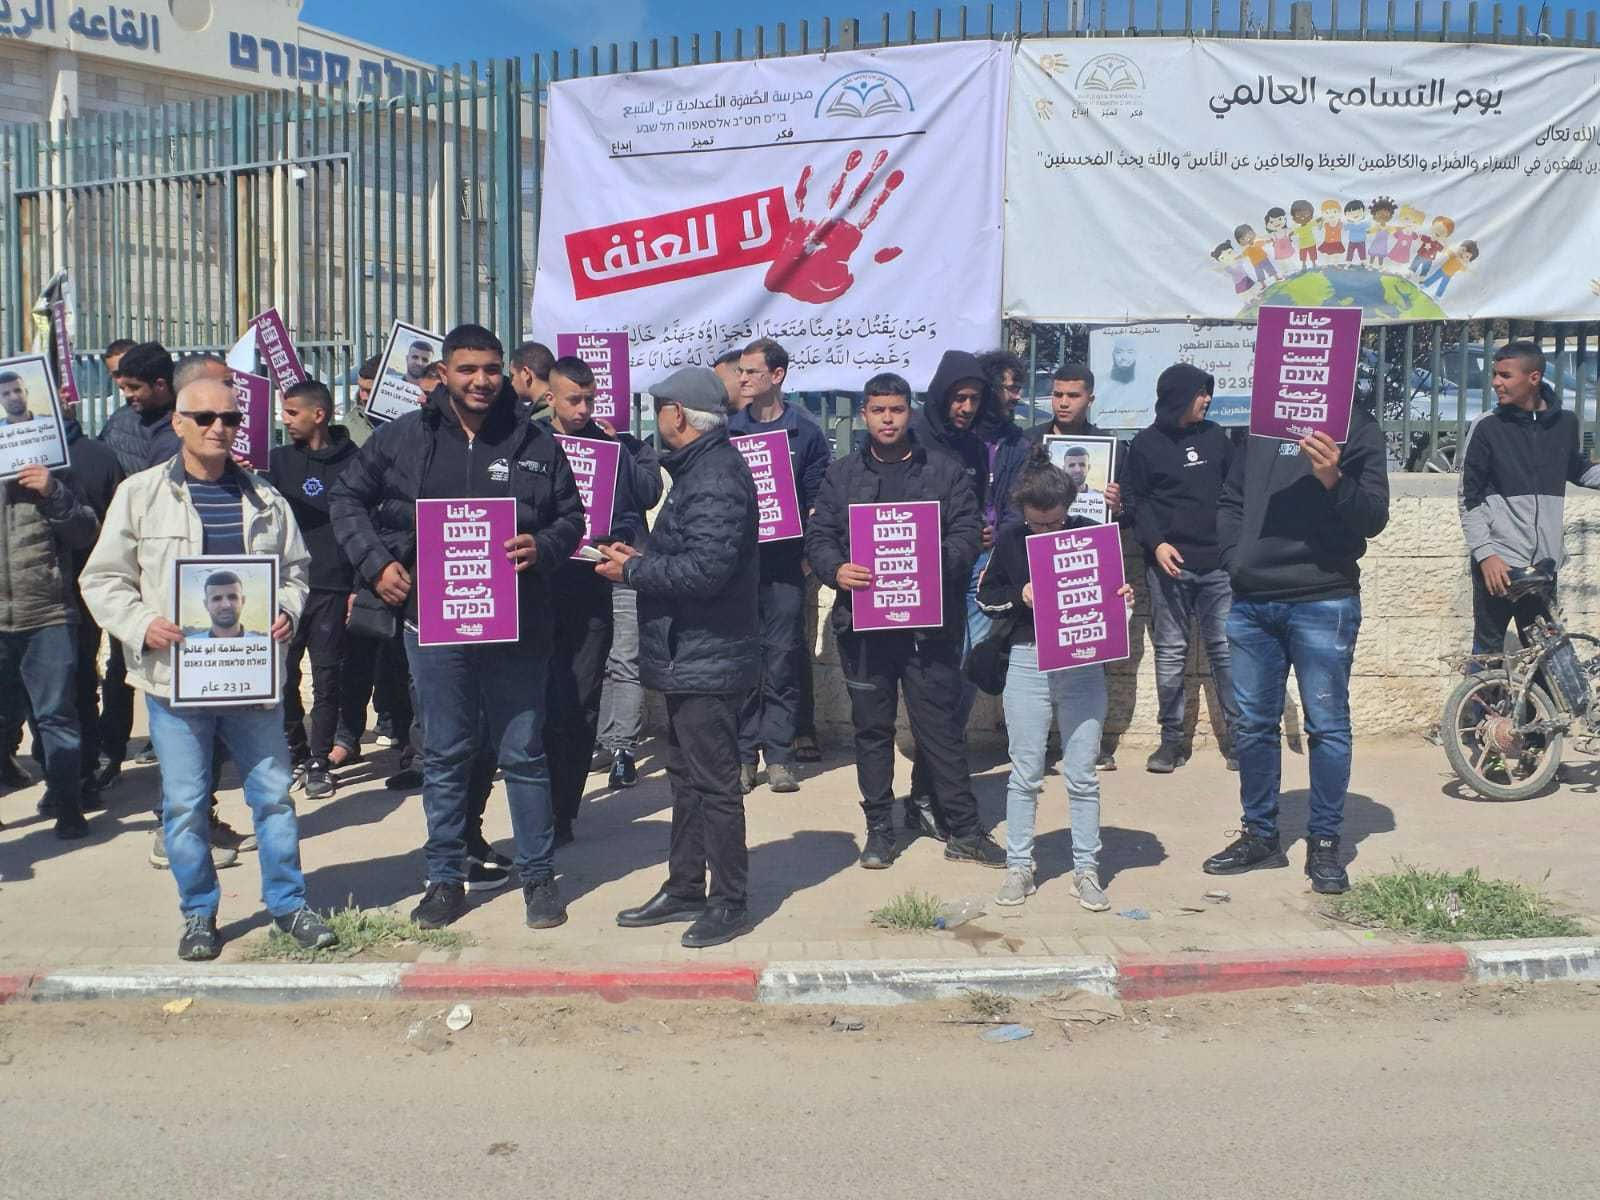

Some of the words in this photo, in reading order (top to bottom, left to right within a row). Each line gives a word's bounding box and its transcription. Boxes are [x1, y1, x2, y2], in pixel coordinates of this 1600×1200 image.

[230, 31, 351, 88] ספורט
[772, 90, 813, 105] مدرسة
[1325, 77, 1446, 114] التسامح
[1452, 87, 1503, 116] يوم
[1535, 124, 1570, 146] تعالى
[1230, 155, 1250, 170] عن
[1318, 153, 1355, 171] الغيظ
[1523, 156, 1541, 177] في
[739, 197, 773, 250] لا
[582, 213, 718, 281] للعنف
[1289, 312, 1332, 328] حياتنا
[1287, 332, 1329, 345] חיינו
[1283, 349, 1330, 366] ليست
[1285, 369, 1325, 381] אינם
[1279, 385, 1327, 403] رخيصة
[1277, 404, 1324, 420] הפקר
[447, 504, 487, 521] حياتنا
[876, 508, 913, 523] حياتنا
[448, 525, 487, 538] חיינו
[877, 526, 913, 538] חיינו
[445, 542, 490, 560] ليست
[875, 541, 916, 556] ليست
[1055, 535, 1094, 551] حياتنا
[449, 562, 487, 576] אינם
[879, 560, 914, 571] אינם
[1058, 553, 1095, 569] חיינו
[875, 576, 918, 590] رخيصة
[1057, 568, 1099, 588] ليست
[445, 581, 492, 598] رخيصة
[1062, 588, 1099, 606] אינם
[877, 593, 917, 607] הפקר
[446, 601, 491, 620] הפקר
[1059, 607, 1103, 625] رخيصة
[1061, 626, 1103, 644] הפקר
[223, 682, 237, 692] 23
